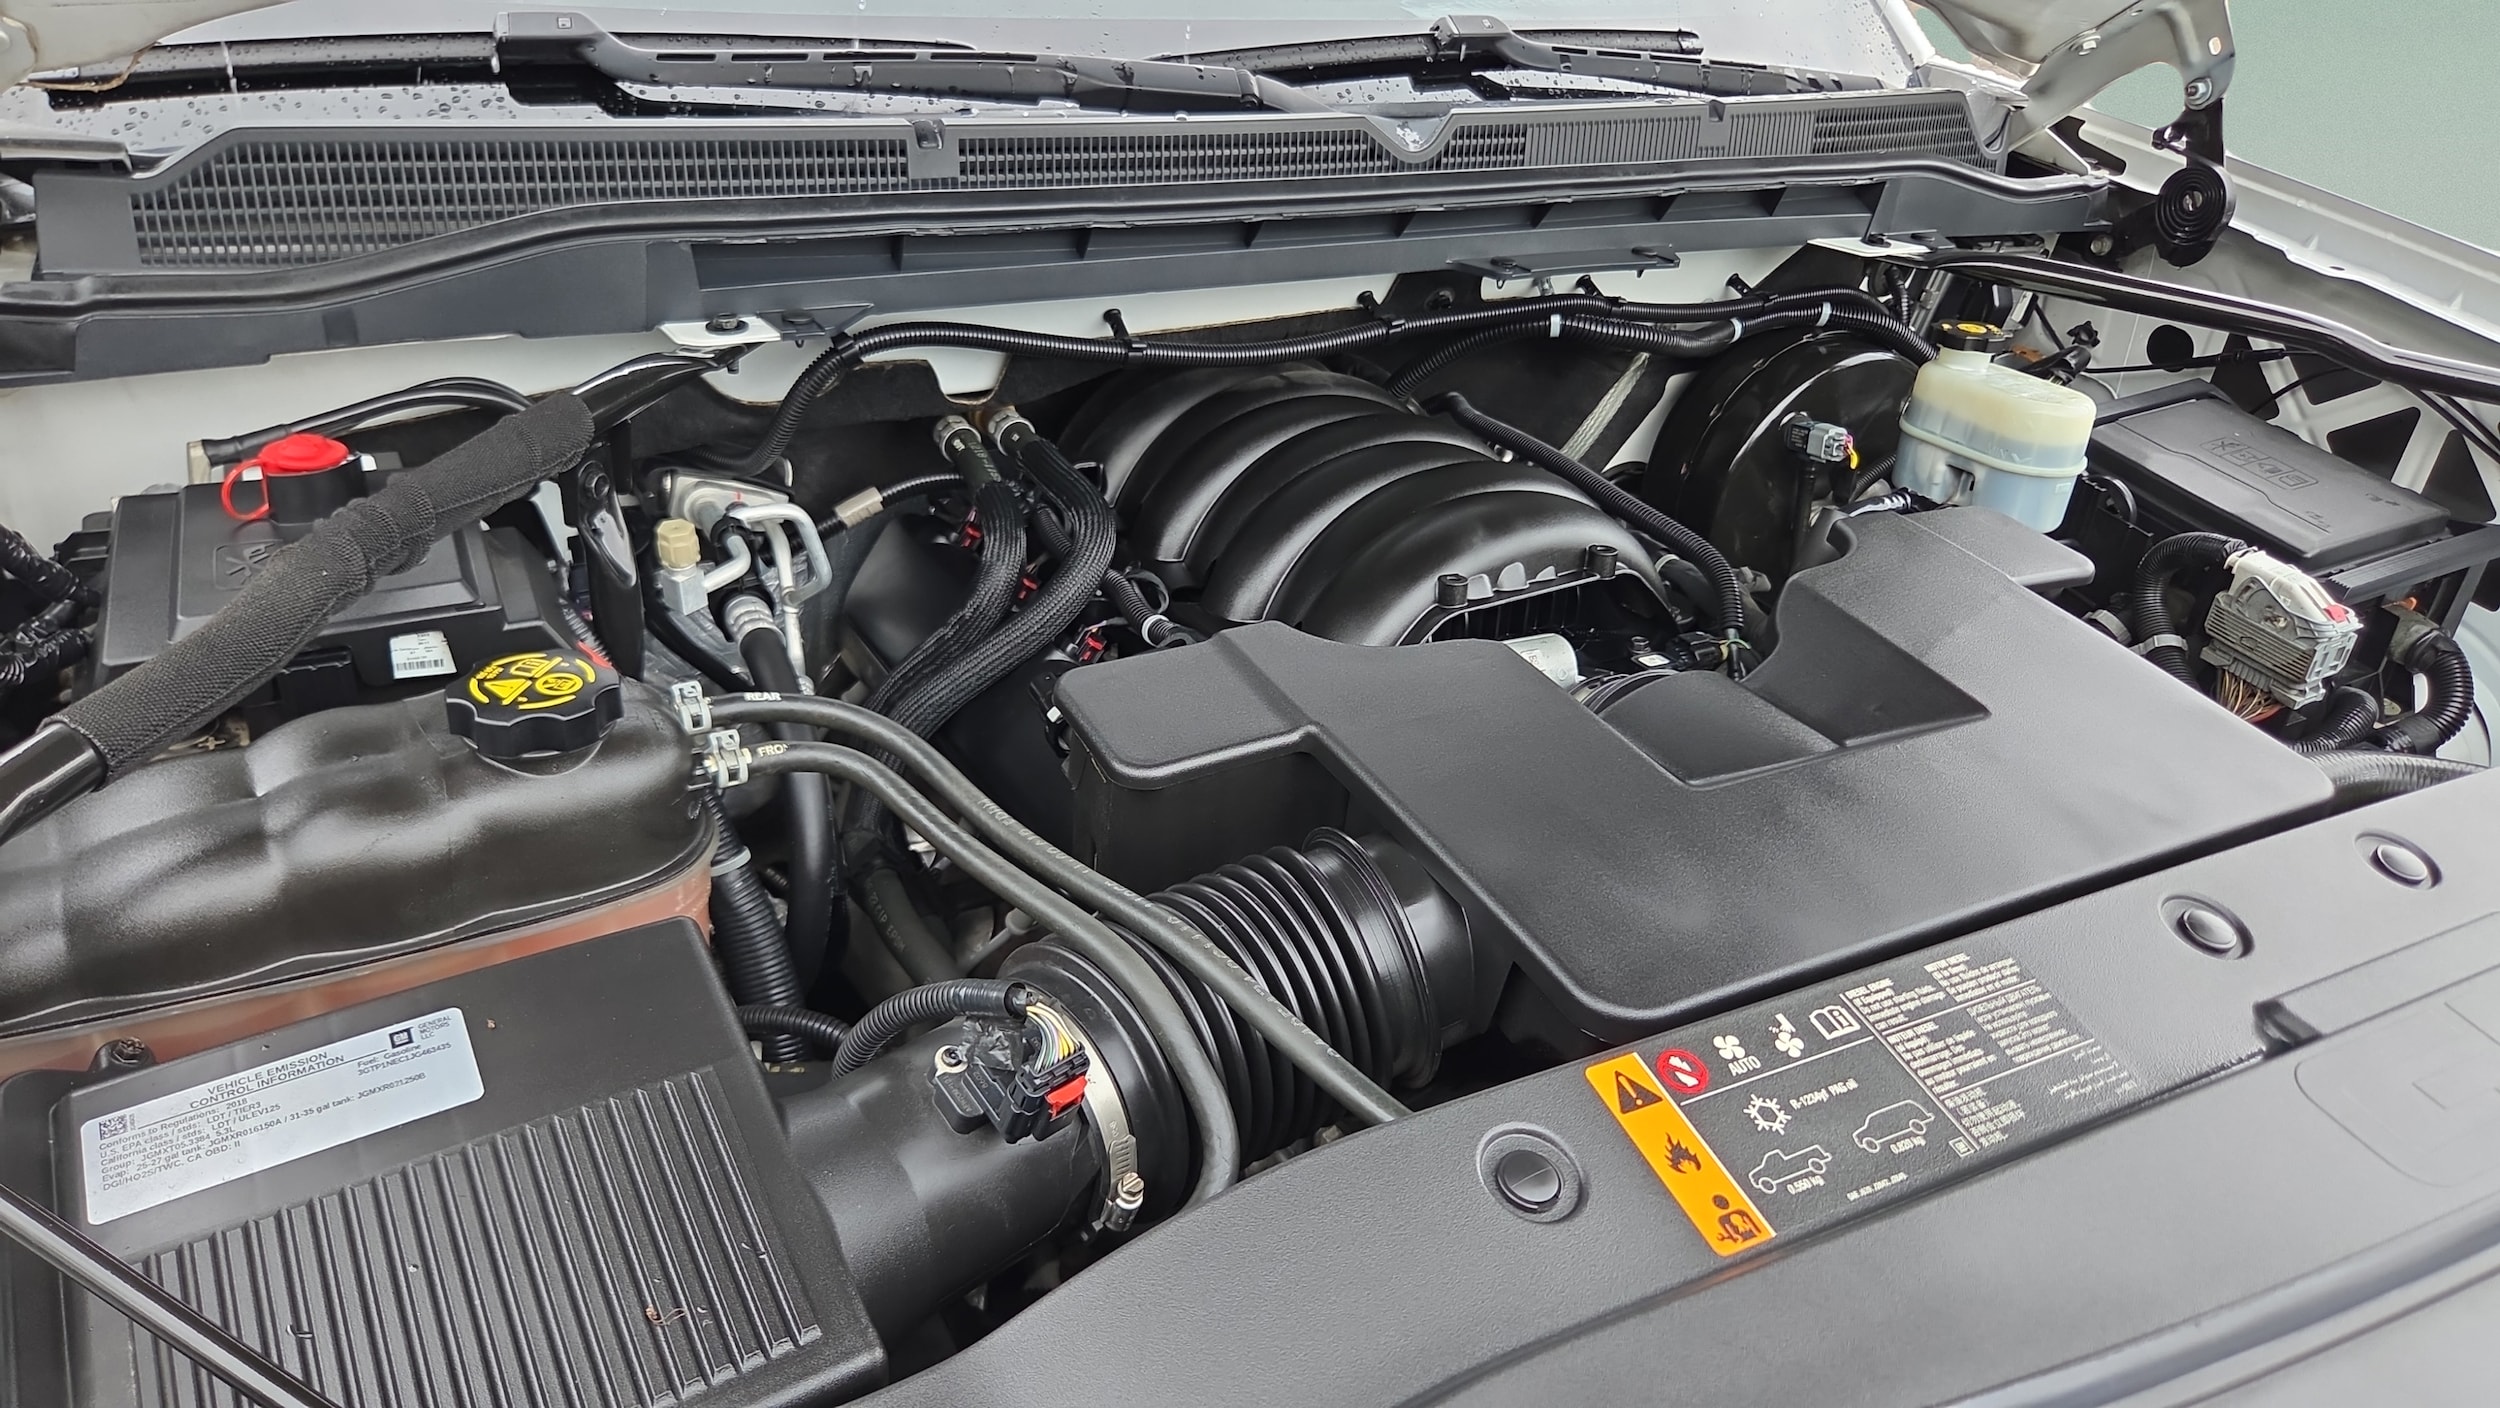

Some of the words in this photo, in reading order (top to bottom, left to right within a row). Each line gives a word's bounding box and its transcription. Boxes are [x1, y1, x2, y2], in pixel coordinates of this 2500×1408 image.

[744, 691, 782, 702] REAR
[418, 1015, 450, 1028] GENERAL
[419, 1022, 449, 1033] MOTORS
[357, 1056, 378, 1067] Fuel:
[383, 1043, 421, 1059] Gasoline
[1728, 1055, 1761, 1076] AUTO
[190, 1083, 253, 1108] CONTROL
[257, 1054, 344, 1087] INFORMATION
[208, 1072, 262, 1094] VEHICLE
[267, 1052, 327, 1075] EMISSION
[1789, 1088, 1829, 1110] R-1234yf
[1828, 1082, 1848, 1096] PAG
[99, 1131, 145, 1149] Conforms
[148, 1126, 157, 1134] to
[161, 1107, 219, 1131] Regulations:
[226, 1098, 247, 1109] 2018
[100, 1147, 118, 1157] U.S.
[122, 1140, 141, 1150] EPA
[144, 1131, 168, 1143] class
[177, 1121, 200, 1133] stds:
[207, 1113, 224, 1123] LDT
[234, 1102, 260, 1114] TIER3
[101, 1146, 146, 1165] California
[149, 1138, 173, 1150] class
[182, 1128, 205, 1139] stds:
[212, 1119, 230, 1129] LDT
[238, 1104, 280, 1121] ULEV125
[102, 1159, 134, 1174] Group:
[140, 1134, 209, 1160] JGMXT05.3384
[216, 1126, 234, 1136] 5.3L
[103, 1169, 128, 1182] Evap:
[137, 1158, 161, 1170] 25-27
[164, 1152, 178, 1161] gal
[182, 1143, 205, 1155] tank:
[208, 1119, 281, 1146] JGMXR016150A
[290, 1108, 313, 1120] 31-35
[316, 1103, 329, 1112] gal
[332, 1095, 354, 1106] tank:
[1912, 1135, 1926, 1147] kg
[187, 1153, 201, 1162] CA
[205, 1144, 231, 1156] OBD:
[1810, 1175, 1826, 1187] kg
